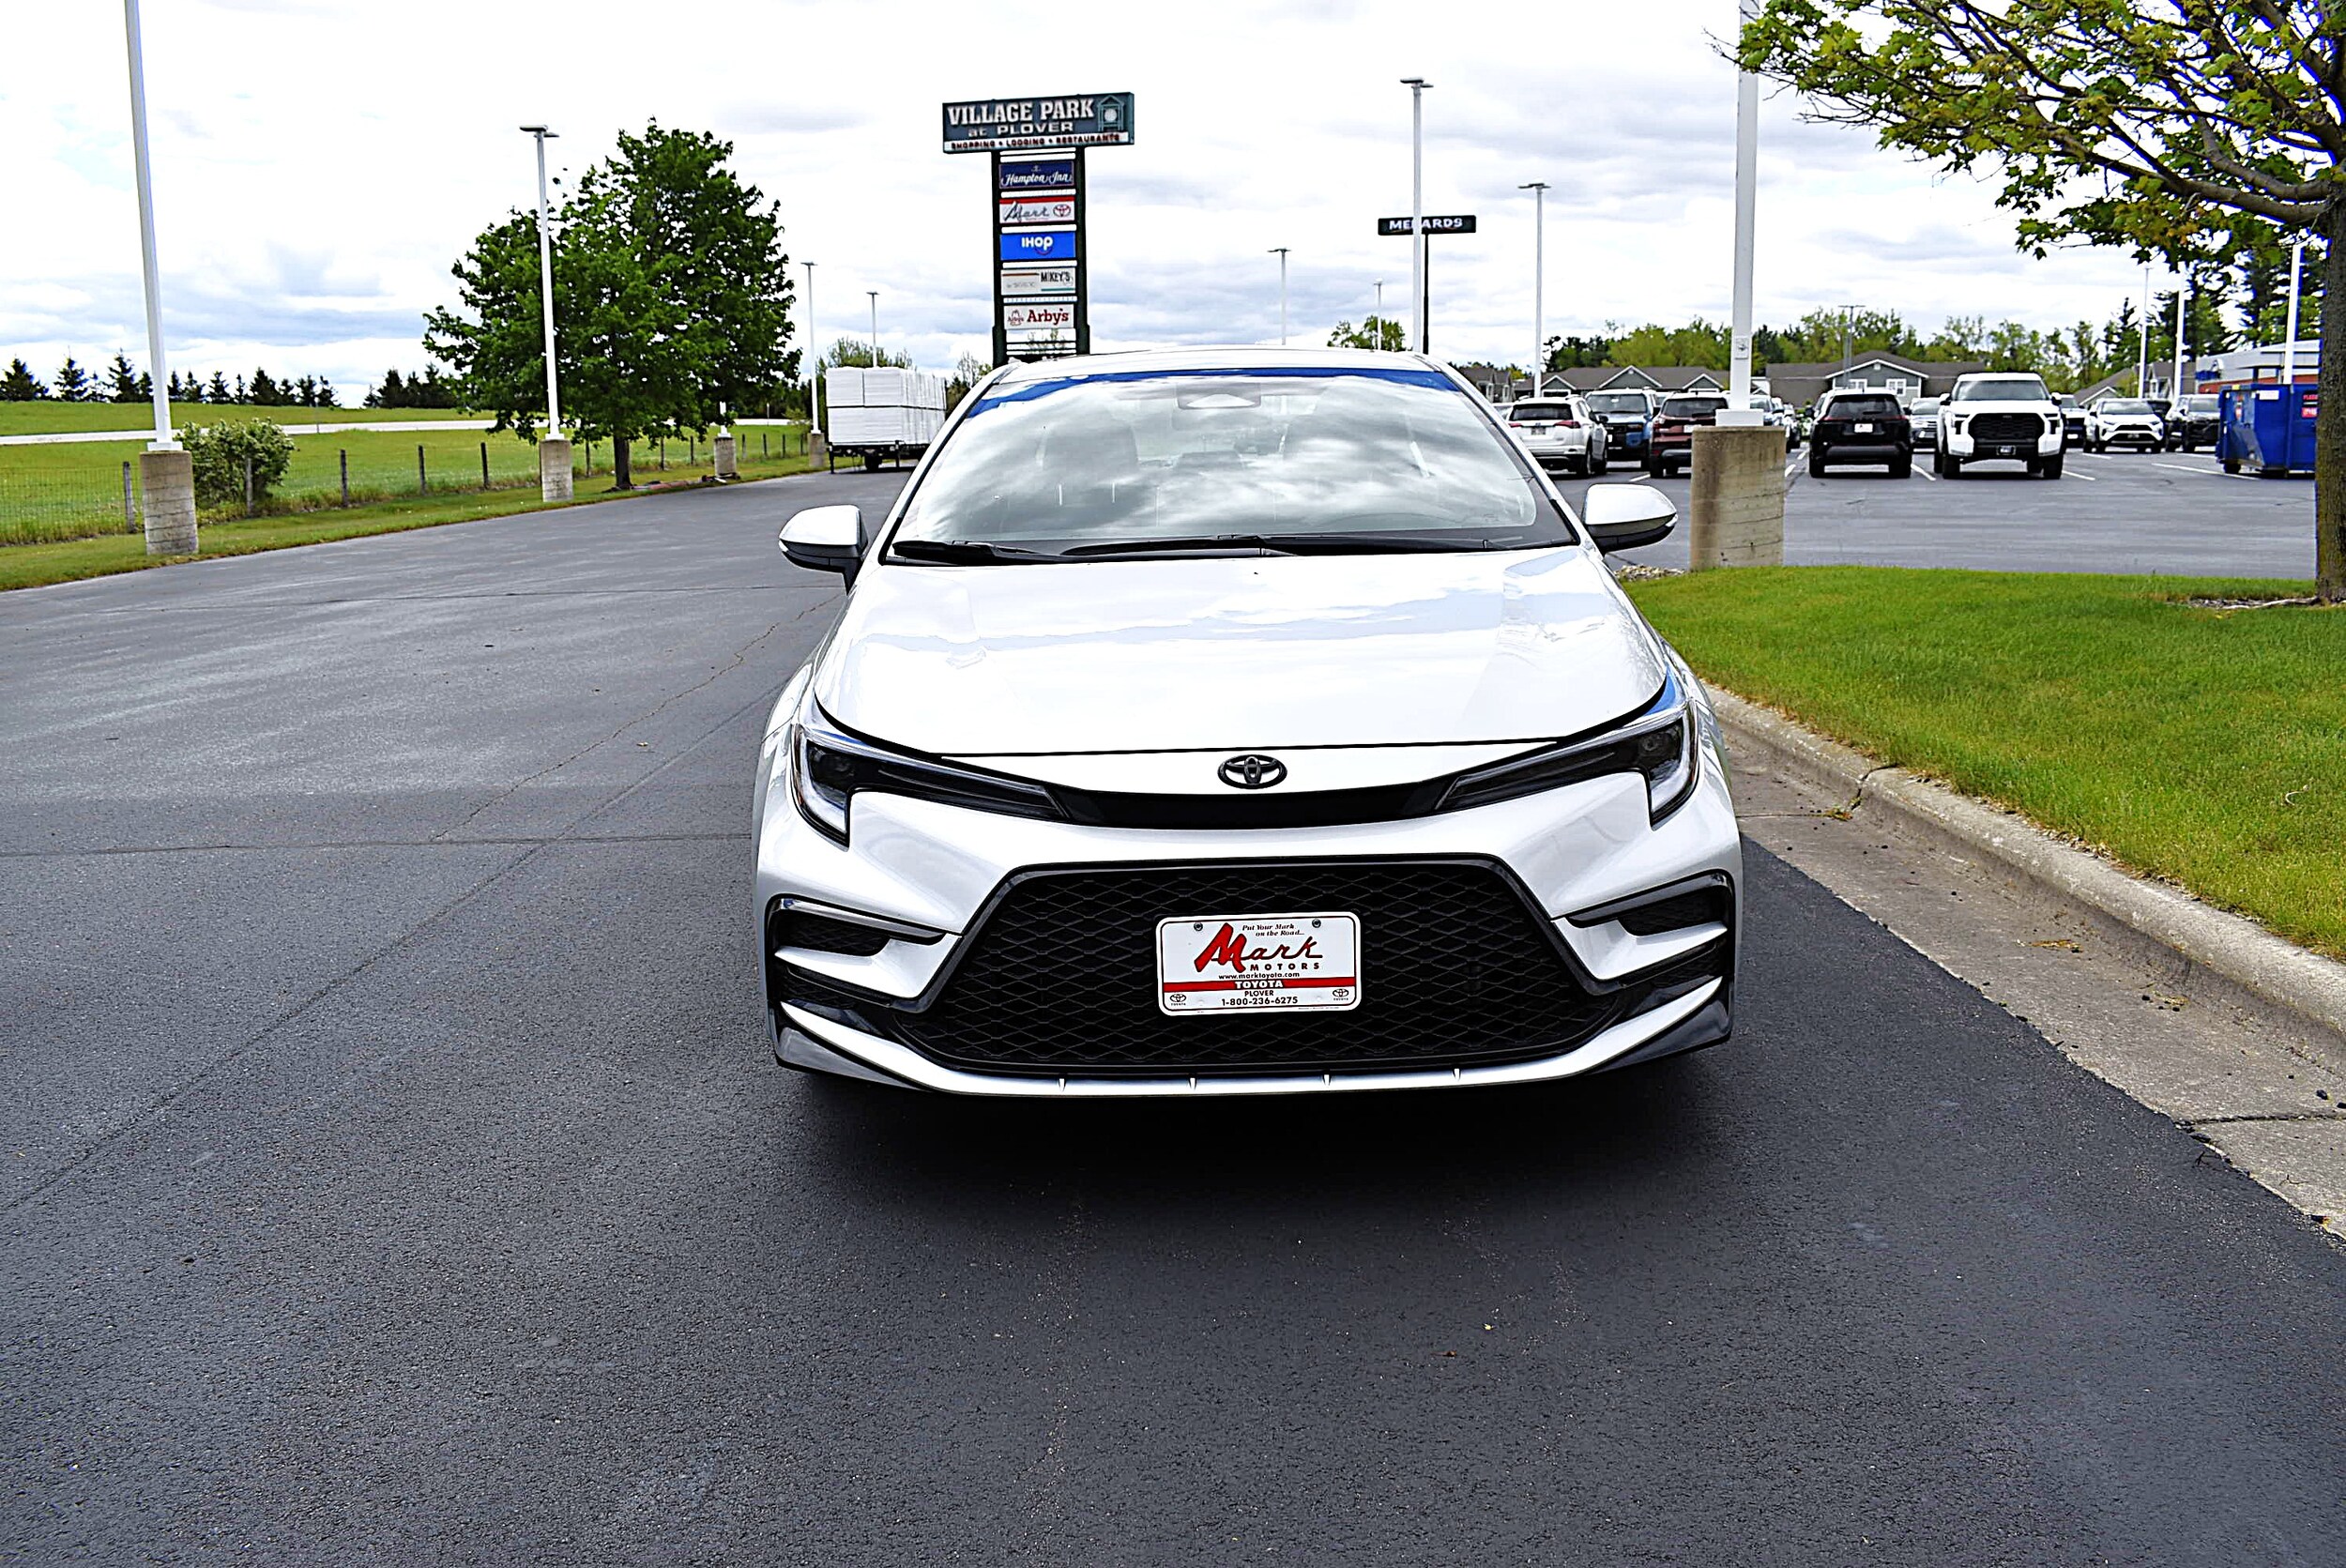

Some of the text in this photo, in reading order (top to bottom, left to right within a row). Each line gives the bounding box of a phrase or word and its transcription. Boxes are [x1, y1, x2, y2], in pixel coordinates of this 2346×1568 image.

[947, 98, 1095, 126] VILLAGE PARK
[967, 121, 1074, 137] at PLOVER
[951, 134, 1120, 149] SHOPPING LODGING RESTAURANTS
[1001, 171, 1074, 186] Hampton Inn
[1004, 201, 1049, 222] Mark
[1389, 218, 1463, 230] MEARDS
[1021, 236, 1053, 251] IHOP
[1028, 309, 1069, 325] Arby's
[1194, 922, 1323, 973] Mark
[1250, 963, 1319, 971] MOTORS
[1218, 971, 1300, 980] www.marktoyota.com
[1235, 980, 1284, 989] TOYOTA
[1222, 997, 1298, 1006] 1-800-236-6275
